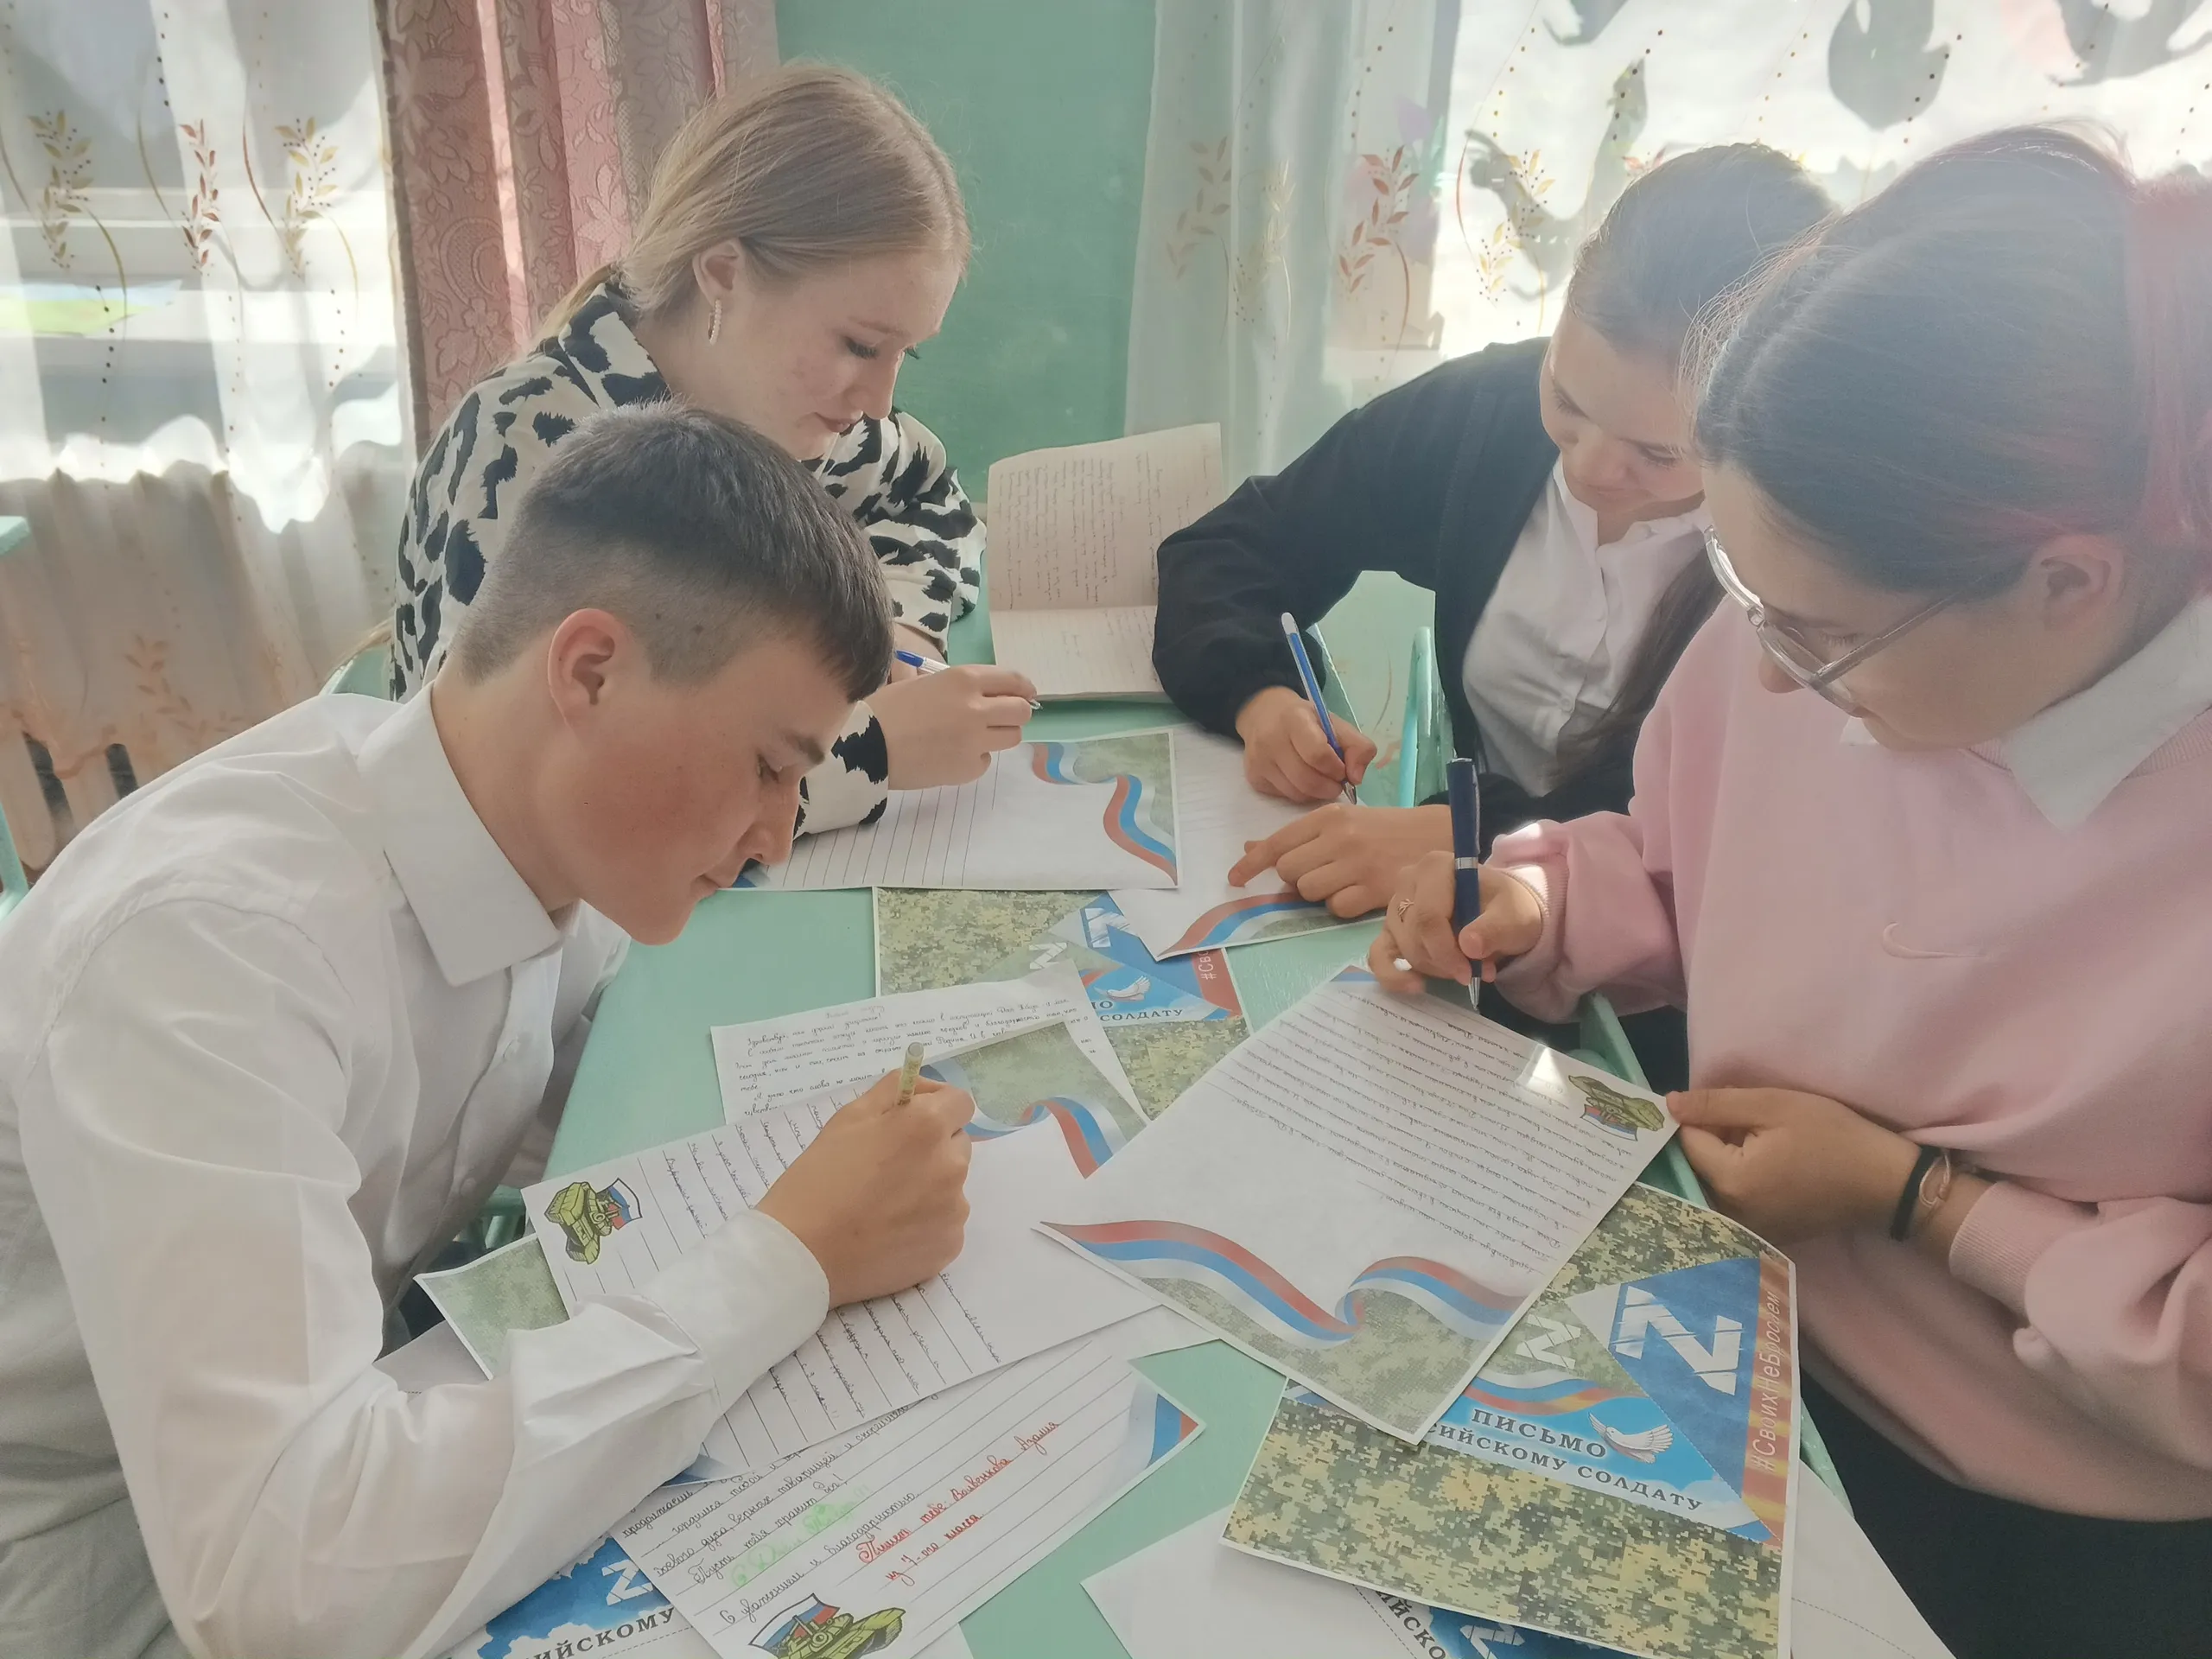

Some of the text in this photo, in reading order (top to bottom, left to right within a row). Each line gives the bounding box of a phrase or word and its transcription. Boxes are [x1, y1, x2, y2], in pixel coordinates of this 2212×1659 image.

[1099, 1008, 1184, 1022] СОЛДАТУ
[1748, 1290, 1781, 1472] #СвоихНеБросаем
[1471, 1408, 1607, 1459] ПИСЬМО
[1577, 1465, 1703, 1511] СОЛДАТУ
